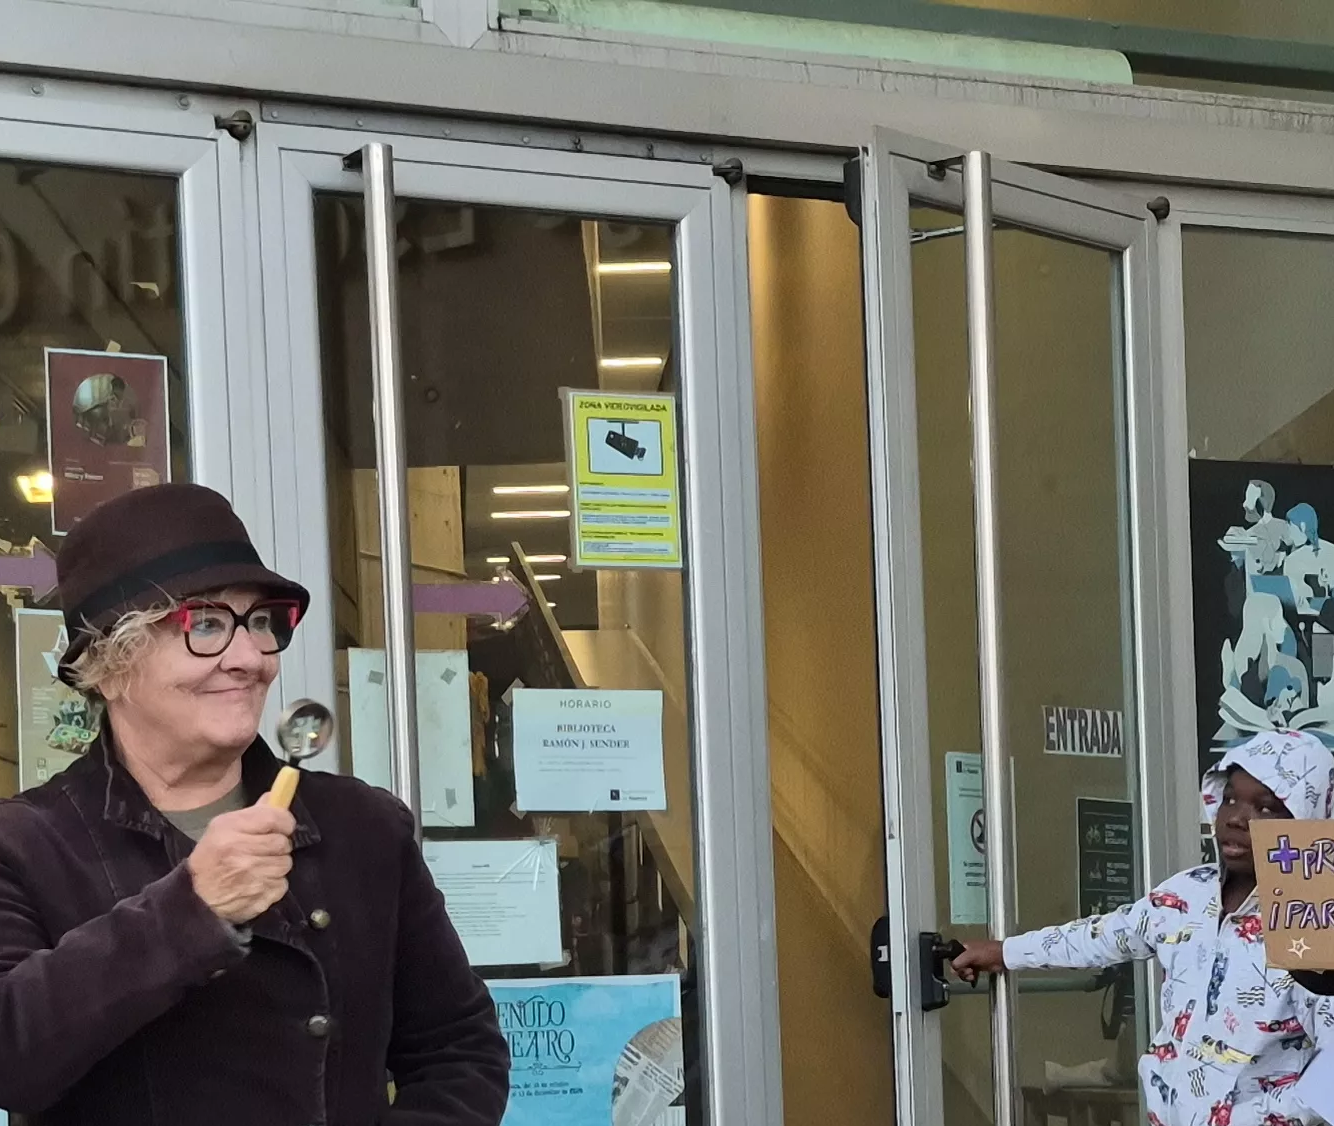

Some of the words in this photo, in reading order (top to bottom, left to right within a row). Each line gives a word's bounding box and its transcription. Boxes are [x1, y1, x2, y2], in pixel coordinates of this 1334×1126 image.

[578, 400, 603, 411] ZONA
[604, 401, 668, 413] VIDEOVIGILADA
[559, 698, 613, 710] HORARIO
[555, 723, 617, 734] BIBLIOTECA
[1045, 706, 1122, 756] ENTRADA
[542, 736, 579, 749] RAMÓN
[589, 738, 631, 750] SENDER
